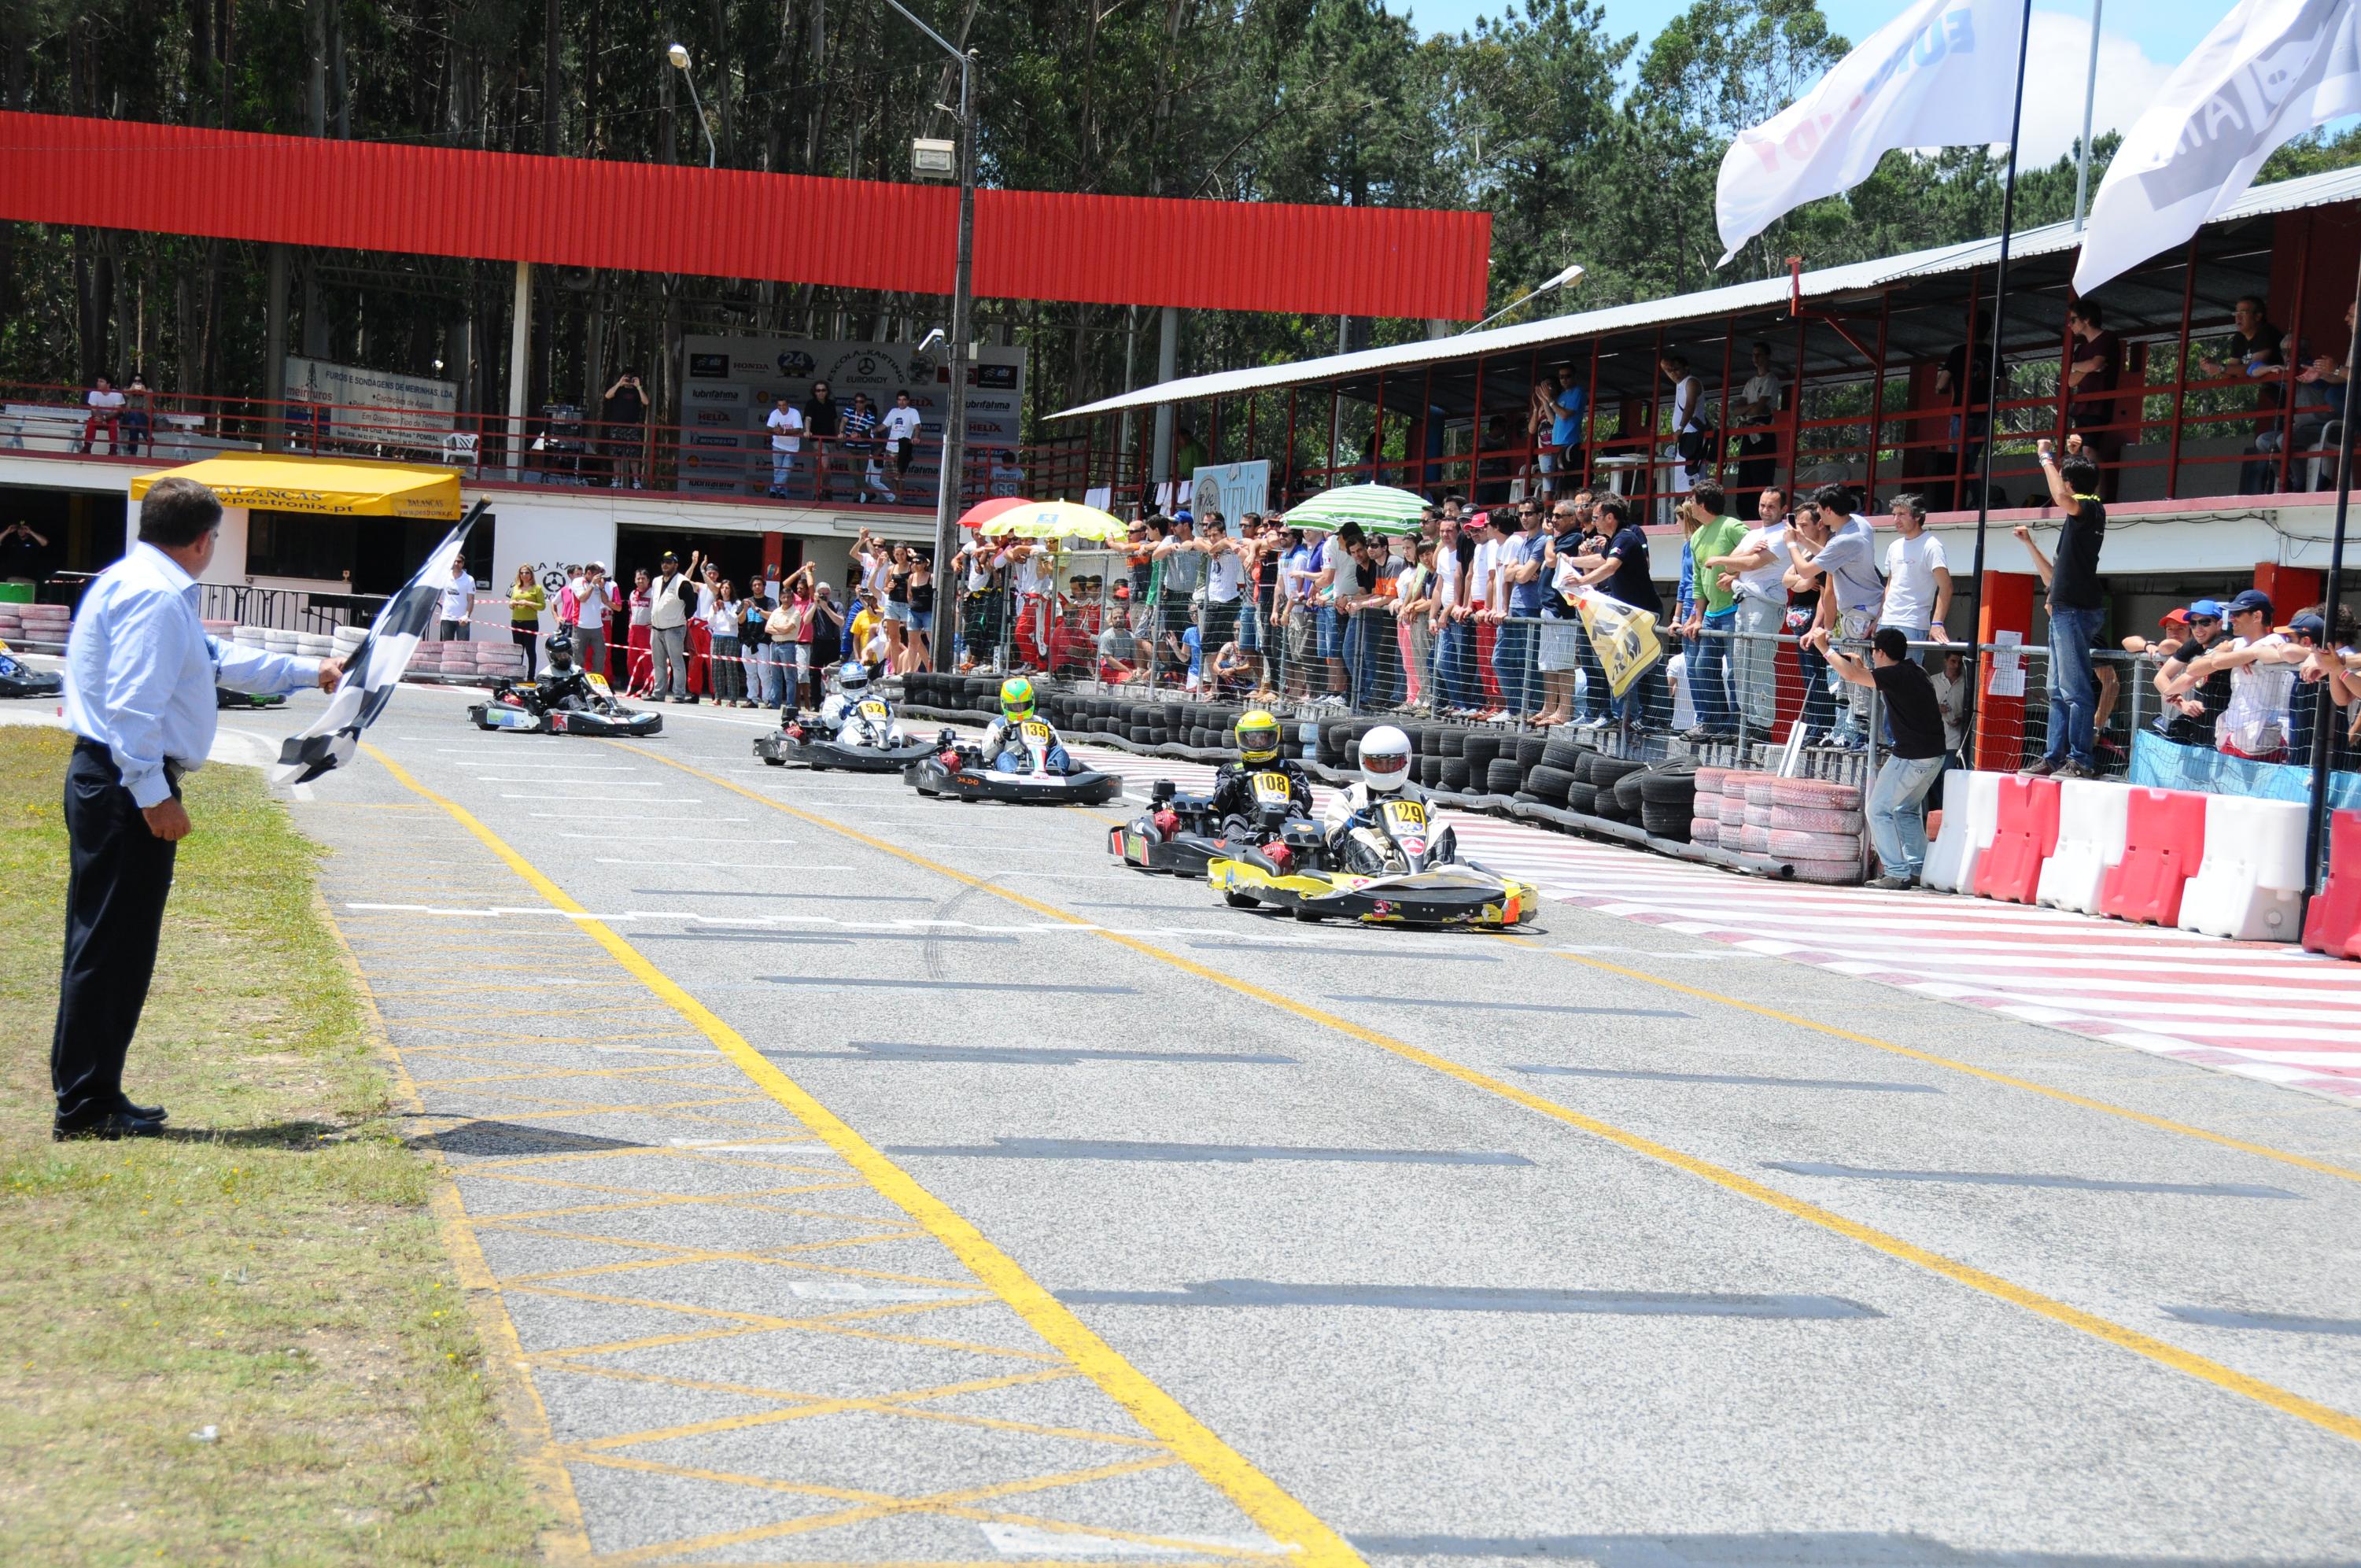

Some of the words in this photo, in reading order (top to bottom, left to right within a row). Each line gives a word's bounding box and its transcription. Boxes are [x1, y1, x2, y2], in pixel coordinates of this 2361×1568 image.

[733, 361, 769, 371] HONDA
[784, 352, 806, 367] 24
[826, 349, 860, 383] ESCOLA
[867, 348, 906, 384] KARTING
[326, 371, 348, 383] FUROS
[349, 375, 355, 384] E
[354, 376, 394, 390] SONDAGENS
[395, 382, 404, 392] DE
[846, 375, 887, 385] EUROINDY
[362, 411, 372, 420] Em
[372, 414, 400, 426] Qualquer
[968, 423, 1003, 433] HELIX
[416, 433, 439, 442] POMBAL
[865, 703, 882, 713] 52
[1023, 723, 1047, 738] 135
[1256, 775, 1287, 792] 108
[1389, 802, 1423, 824] 129
